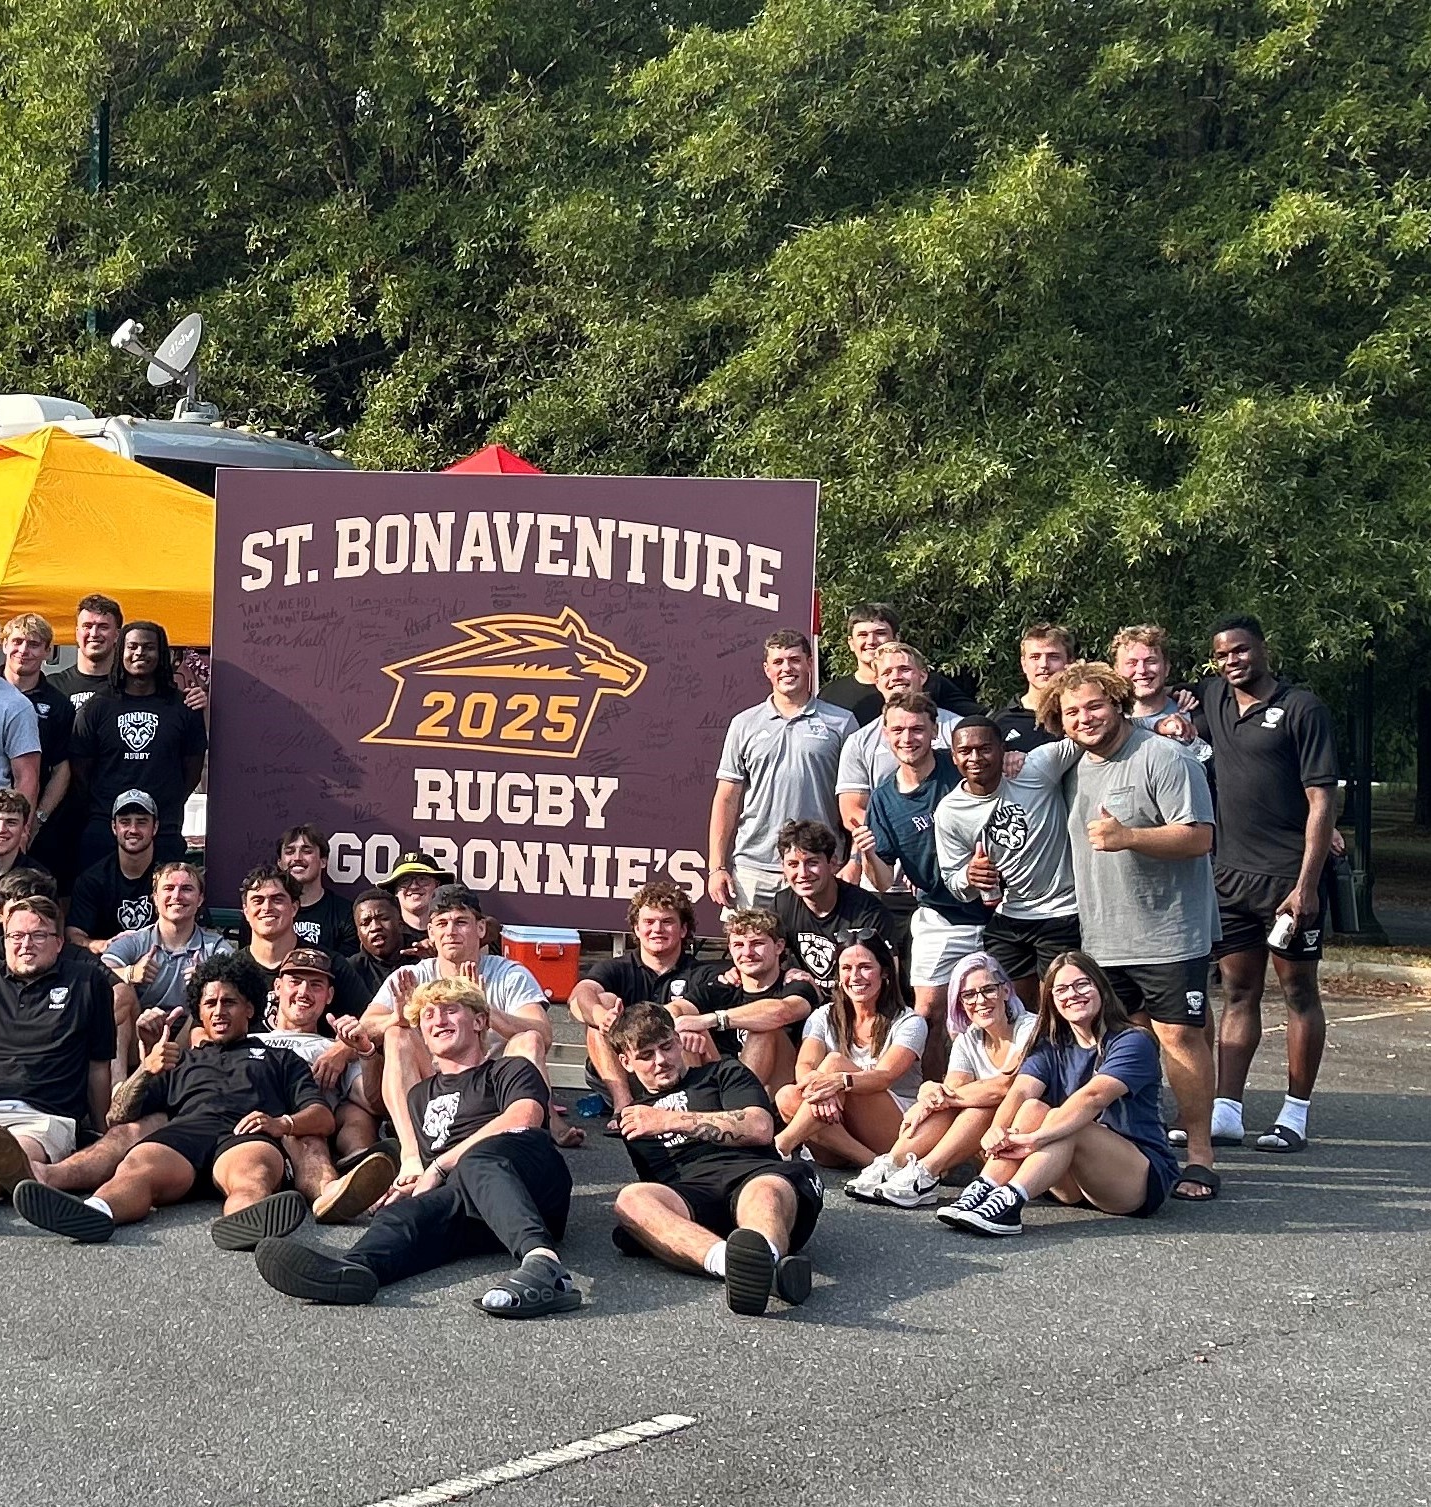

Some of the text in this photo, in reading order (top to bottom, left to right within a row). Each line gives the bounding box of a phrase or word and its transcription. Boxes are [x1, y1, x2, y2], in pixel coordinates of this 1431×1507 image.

[241, 511, 782, 612] ST. BONAVENTURE
[117, 712, 159, 728] BONNIES
[415, 691, 580, 742] 2025
[412, 768, 619, 829] RUGBY
[327, 832, 400, 884] GO
